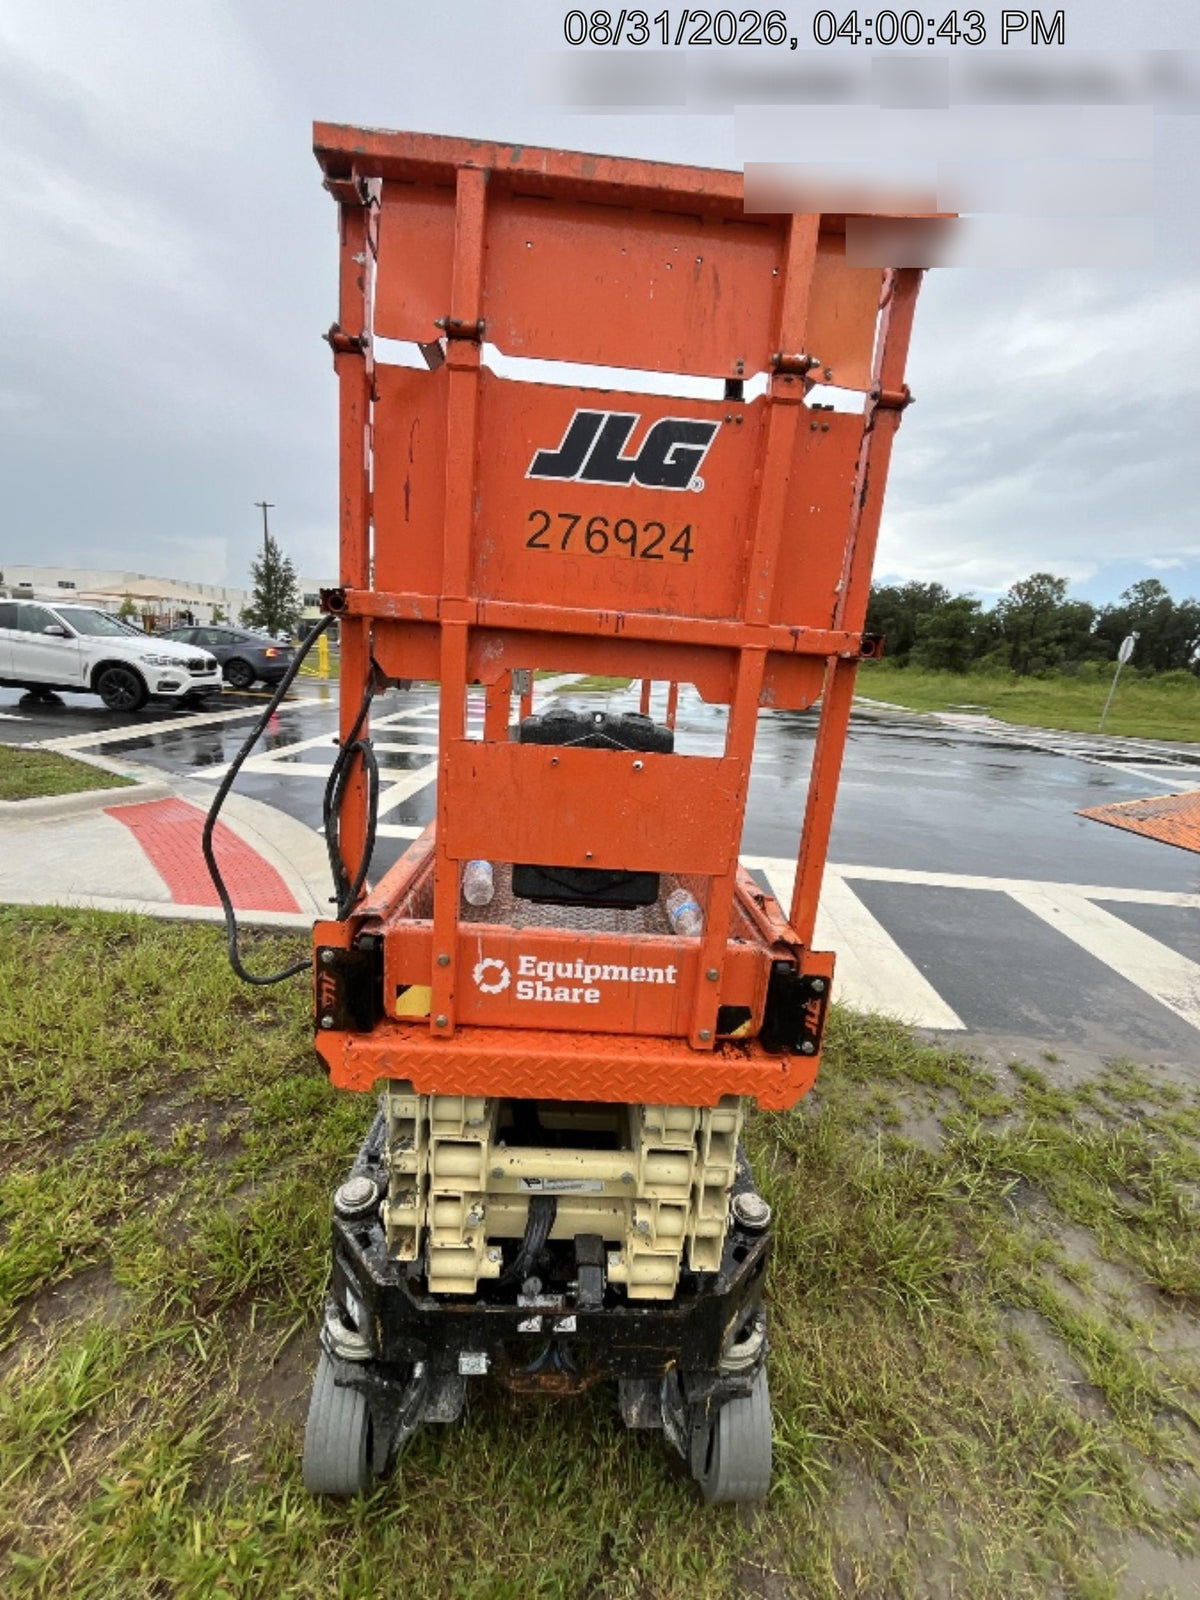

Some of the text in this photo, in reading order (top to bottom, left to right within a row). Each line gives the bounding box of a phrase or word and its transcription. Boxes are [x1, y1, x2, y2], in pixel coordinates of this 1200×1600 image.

[525, 509, 694, 562] 276924
[517, 955, 678, 984] Equipment
[515, 980, 600, 1004] Share
